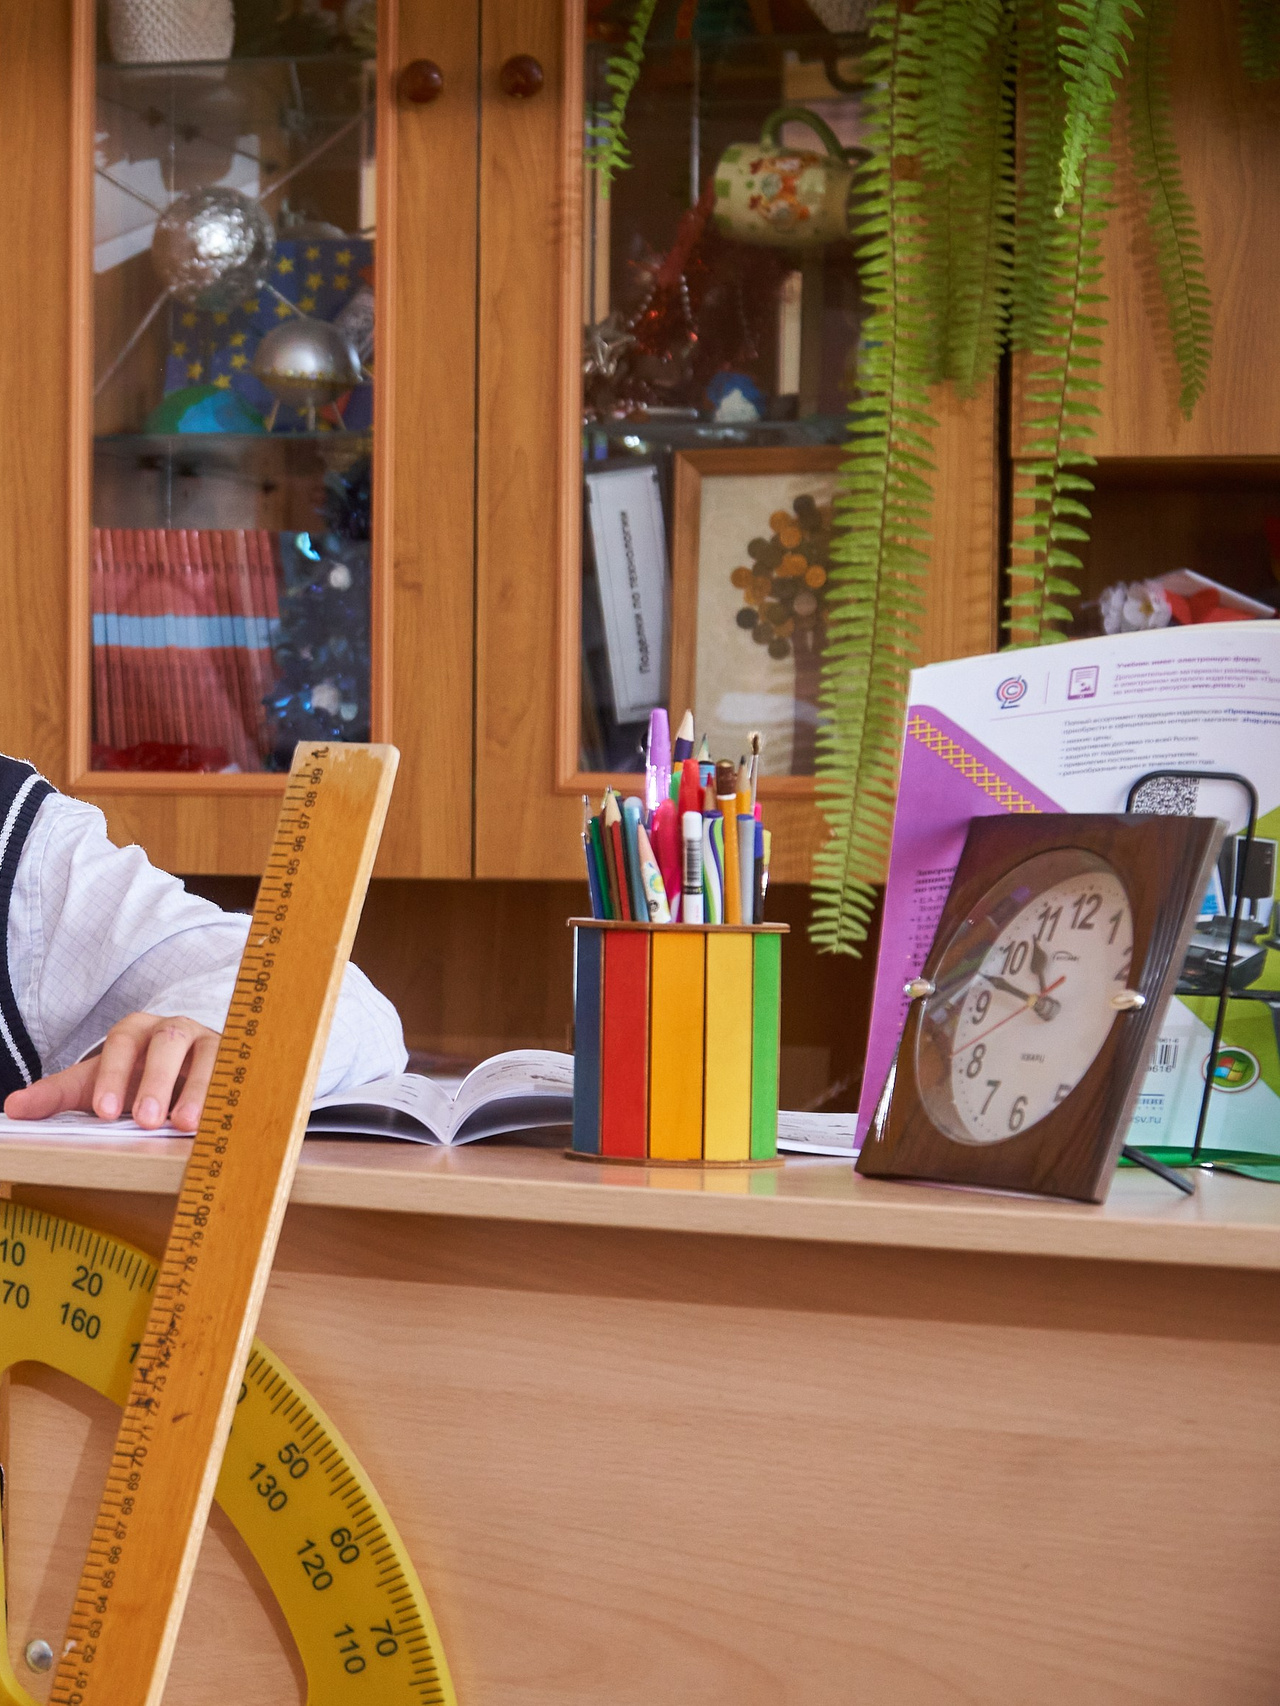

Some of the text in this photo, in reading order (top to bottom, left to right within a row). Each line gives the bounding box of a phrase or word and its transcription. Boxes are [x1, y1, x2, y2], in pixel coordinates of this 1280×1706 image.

[310, 768, 324, 785] 99
[304, 790, 318, 808] 98
[298, 812, 311, 830] 97
[292, 835, 307, 852] 96
[286, 858, 301, 876] 95
[280, 882, 293, 899] 94
[274, 904, 289, 922] 93
[1071, 892, 1104, 930] 12
[1037, 905, 1064, 942] 11
[1108, 908, 1124, 945] 1
[269, 927, 283, 944] 92
[262, 952, 277, 968] 91
[1001, 940, 1029, 976] 10
[254, 971, 271, 993] 90
[250, 996, 265, 1014] 89
[972, 989, 992, 1025] 9
[244, 1019, 259, 1037] 88
[238, 1042, 253, 1060] 87
[966, 1042, 987, 1079] 8
[232, 1066, 247, 1085] 86
[226, 1089, 241, 1107] 85
[980, 1079, 1002, 1115] 7
[220, 1113, 235, 1131] 84
[1008, 1095, 1029, 1132] 6
[214, 1136, 229, 1155] 83
[208, 1160, 223, 1178] 82
[202, 1185, 216, 1202] 81
[193, 1205, 211, 1227] 80
[190, 1231, 204, 1249] 79
[0, 1238, 26, 1267] 10
[183, 1255, 198, 1273] 78
[71, 1265, 104, 1298] 20
[177, 1278, 192, 1296] 77
[59, 1301, 102, 1341] 160
[172, 1303, 186, 1320] 76
[152, 1375, 167, 1393] 73
[139, 1424, 154, 1442] 71
[130, 1445, 148, 1468] 70
[277, 1441, 311, 1481] 50
[127, 1472, 141, 1491] 69
[248, 1461, 290, 1513] 130
[121, 1496, 135, 1516] 68
[114, 1521, 128, 1540] 67
[108, 1545, 123, 1565] 66
[329, 1526, 361, 1566] 60
[295, 1538, 334, 1593] 120
[101, 1570, 116, 1589] 65
[95, 1595, 109, 1614] 64
[88, 1619, 103, 1639] 63
[368, 1618, 400, 1658] 70
[82, 1644, 97, 1664] 62
[332, 1623, 367, 1676] 110
[75, 1670, 90, 1689] 61
